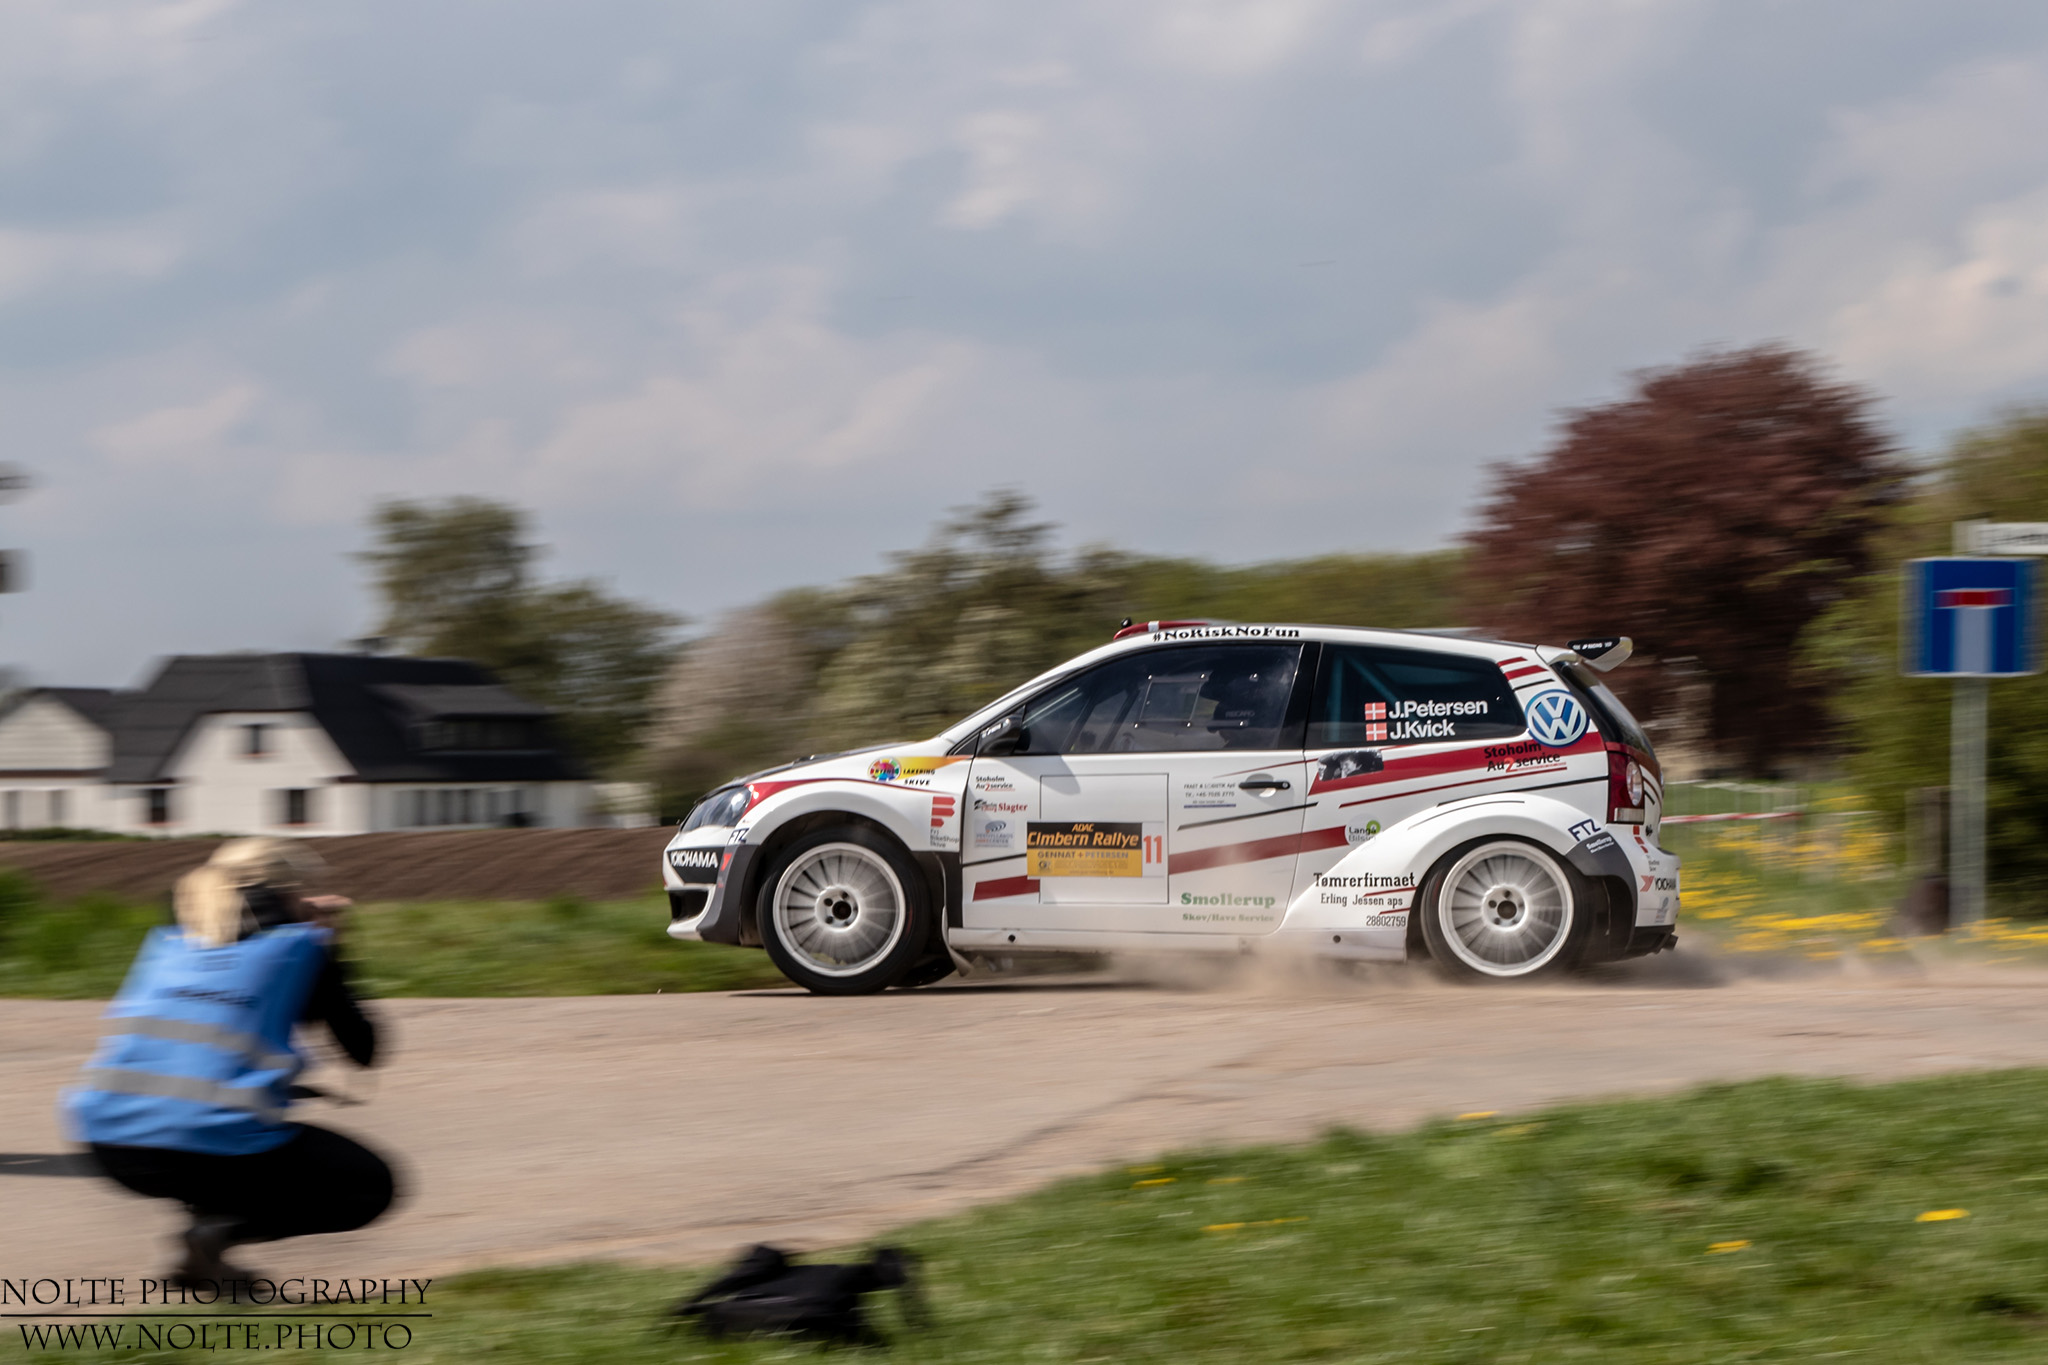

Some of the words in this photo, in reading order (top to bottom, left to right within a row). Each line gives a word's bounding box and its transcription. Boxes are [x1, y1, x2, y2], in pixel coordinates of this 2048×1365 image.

[1152, 627, 1300, 642] #NoRiskNoFun
[1388, 700, 1488, 719] J.Petersen
[1389, 719, 1455, 740] J.Kvick
[1484, 742, 1541, 759] Stoholm
[998, 803, 1027, 813] Slagter
[1072, 824, 1095, 832] ADAC
[1568, 818, 1601, 841] FTZ
[1093, 832, 1139, 848] Rallye
[1143, 835, 1162, 864] 11
[1314, 872, 1415, 887] Tømrerfirmaet
[1181, 892, 1275, 908] Smollerup
[1321, 893, 1347, 907] Erling
[1353, 895, 1384, 905] Jessen
[1388, 898, 1403, 908] aps
[1366, 916, 1406, 927] 28802759
